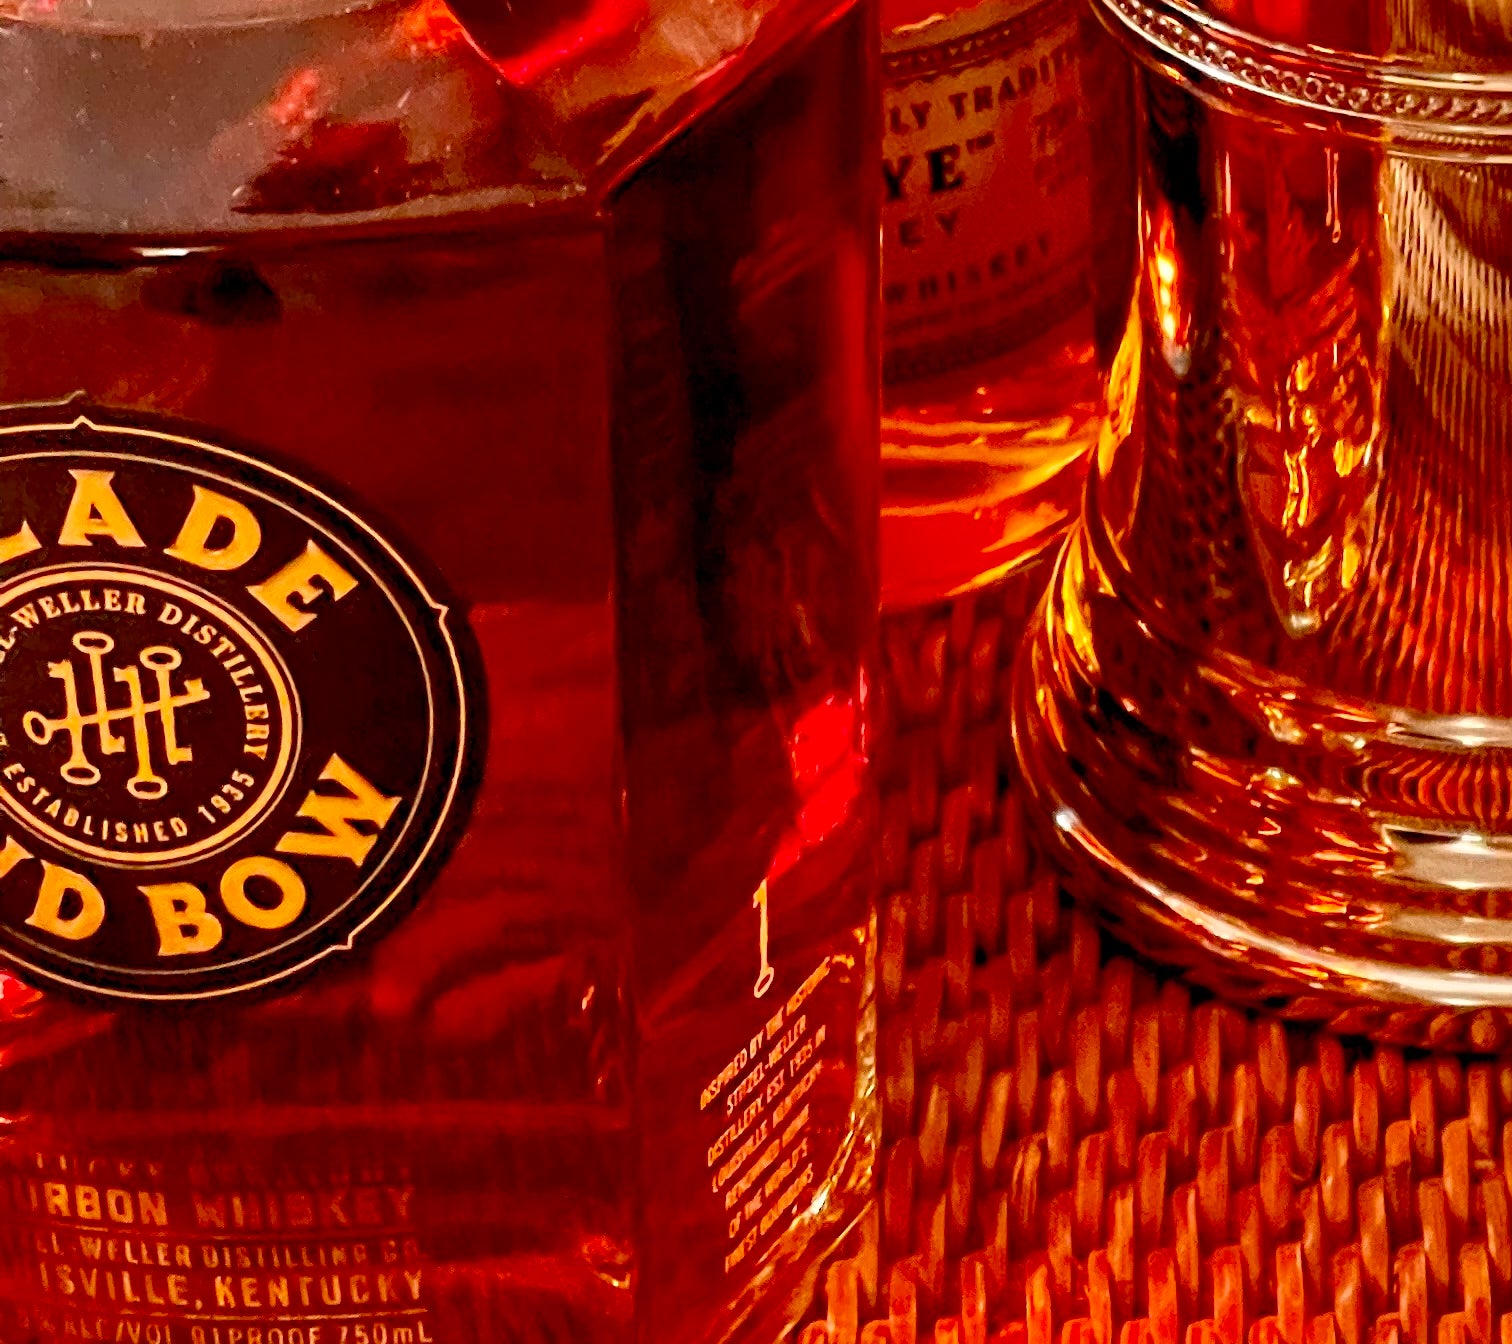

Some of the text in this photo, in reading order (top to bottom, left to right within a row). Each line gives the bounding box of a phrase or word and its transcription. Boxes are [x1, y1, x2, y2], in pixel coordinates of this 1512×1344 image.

[157, 602, 271, 762] DISTILLERY
[2, 762, 256, 844] ESTABLISHED 1935
[136, 752, 403, 957] BOW
[749, 1028, 764, 1060] BY
[214, 1267, 423, 1310] KENTUCKY
